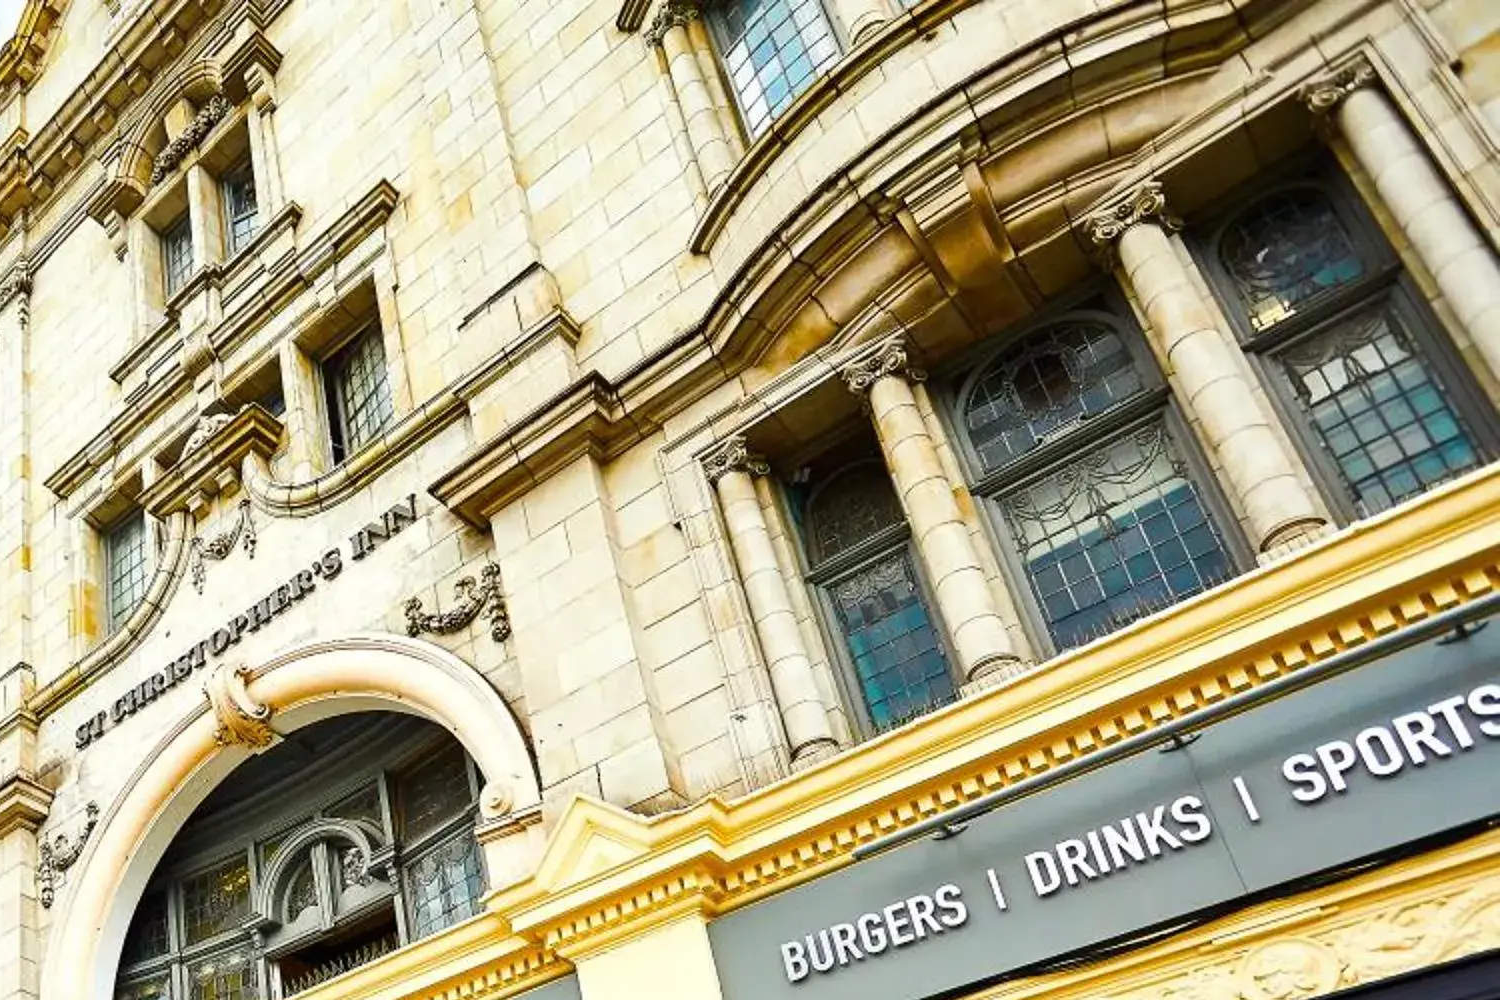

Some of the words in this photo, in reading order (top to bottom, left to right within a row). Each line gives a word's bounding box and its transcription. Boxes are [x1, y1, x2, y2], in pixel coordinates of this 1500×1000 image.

[75, 710, 107, 750] ST
[109, 546, 343, 724] CHRISTOPHER'S
[348, 493, 418, 560] INN
[780, 884, 968, 982] BURGERS
[1024, 795, 1212, 897] DRINKS
[1282, 683, 1500, 803] SPORTS
